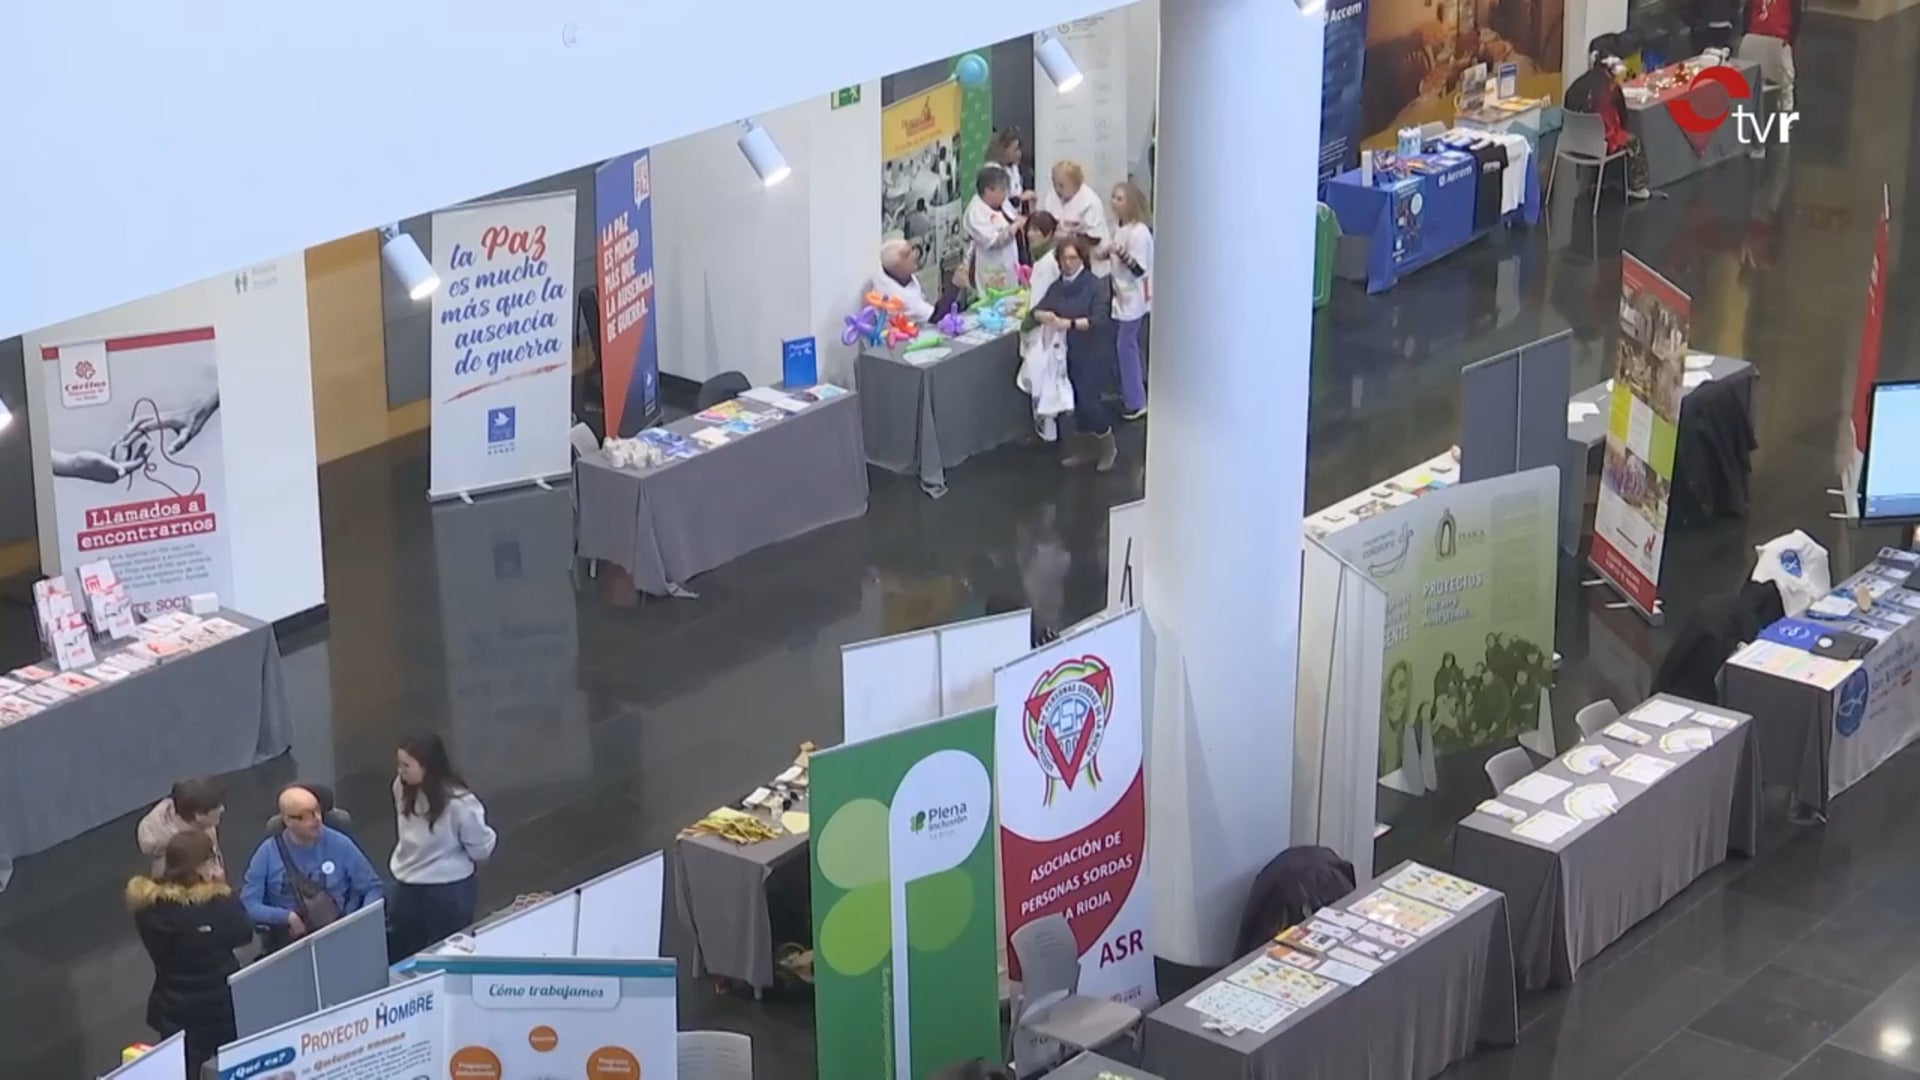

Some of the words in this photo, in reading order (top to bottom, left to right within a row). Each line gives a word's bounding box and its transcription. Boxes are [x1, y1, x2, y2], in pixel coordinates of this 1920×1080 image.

[1330, 2, 1362, 22] Accem
[451, 243, 475, 270] la
[481, 225, 547, 262] Paz
[602, 223, 613, 247] LA
[613, 211, 628, 239] PAZ
[604, 247, 614, 271] ES
[614, 228, 640, 263] MUCHO
[620, 254, 636, 284] QUE
[449, 277, 470, 298] es
[475, 256, 548, 290] mucho
[605, 295, 616, 320] LA
[617, 267, 653, 310] AUSENCIA
[440, 297, 491, 325] más
[496, 289, 538, 317] que
[541, 277, 567, 303] la
[454, 310, 557, 350] ausencia
[607, 318, 616, 343] DE
[454, 349, 482, 376] de
[487, 335, 562, 376] guerra
[81, 517, 214, 549] encontrarnos
[91, 502, 182, 528] Llamados
[188, 500, 200, 513] a
[1424, 572, 1484, 599] PROYECTOS
[929, 803, 967, 822] Plena
[1030, 839, 1101, 884] ASOCIACIÓN
[1105, 830, 1122, 850] DE
[1021, 878, 1080, 917] PERSONAS
[1082, 854, 1133, 886] SORDAS
[1076, 890, 1112, 916] RIOJA
[1100, 929, 1144, 969] ASR
[489, 983, 526, 997] Cómo
[528, 984, 604, 1000] trabajamos
[301, 1017, 370, 1056] PROYECTO
[375, 994, 434, 1029] HOMBRE
